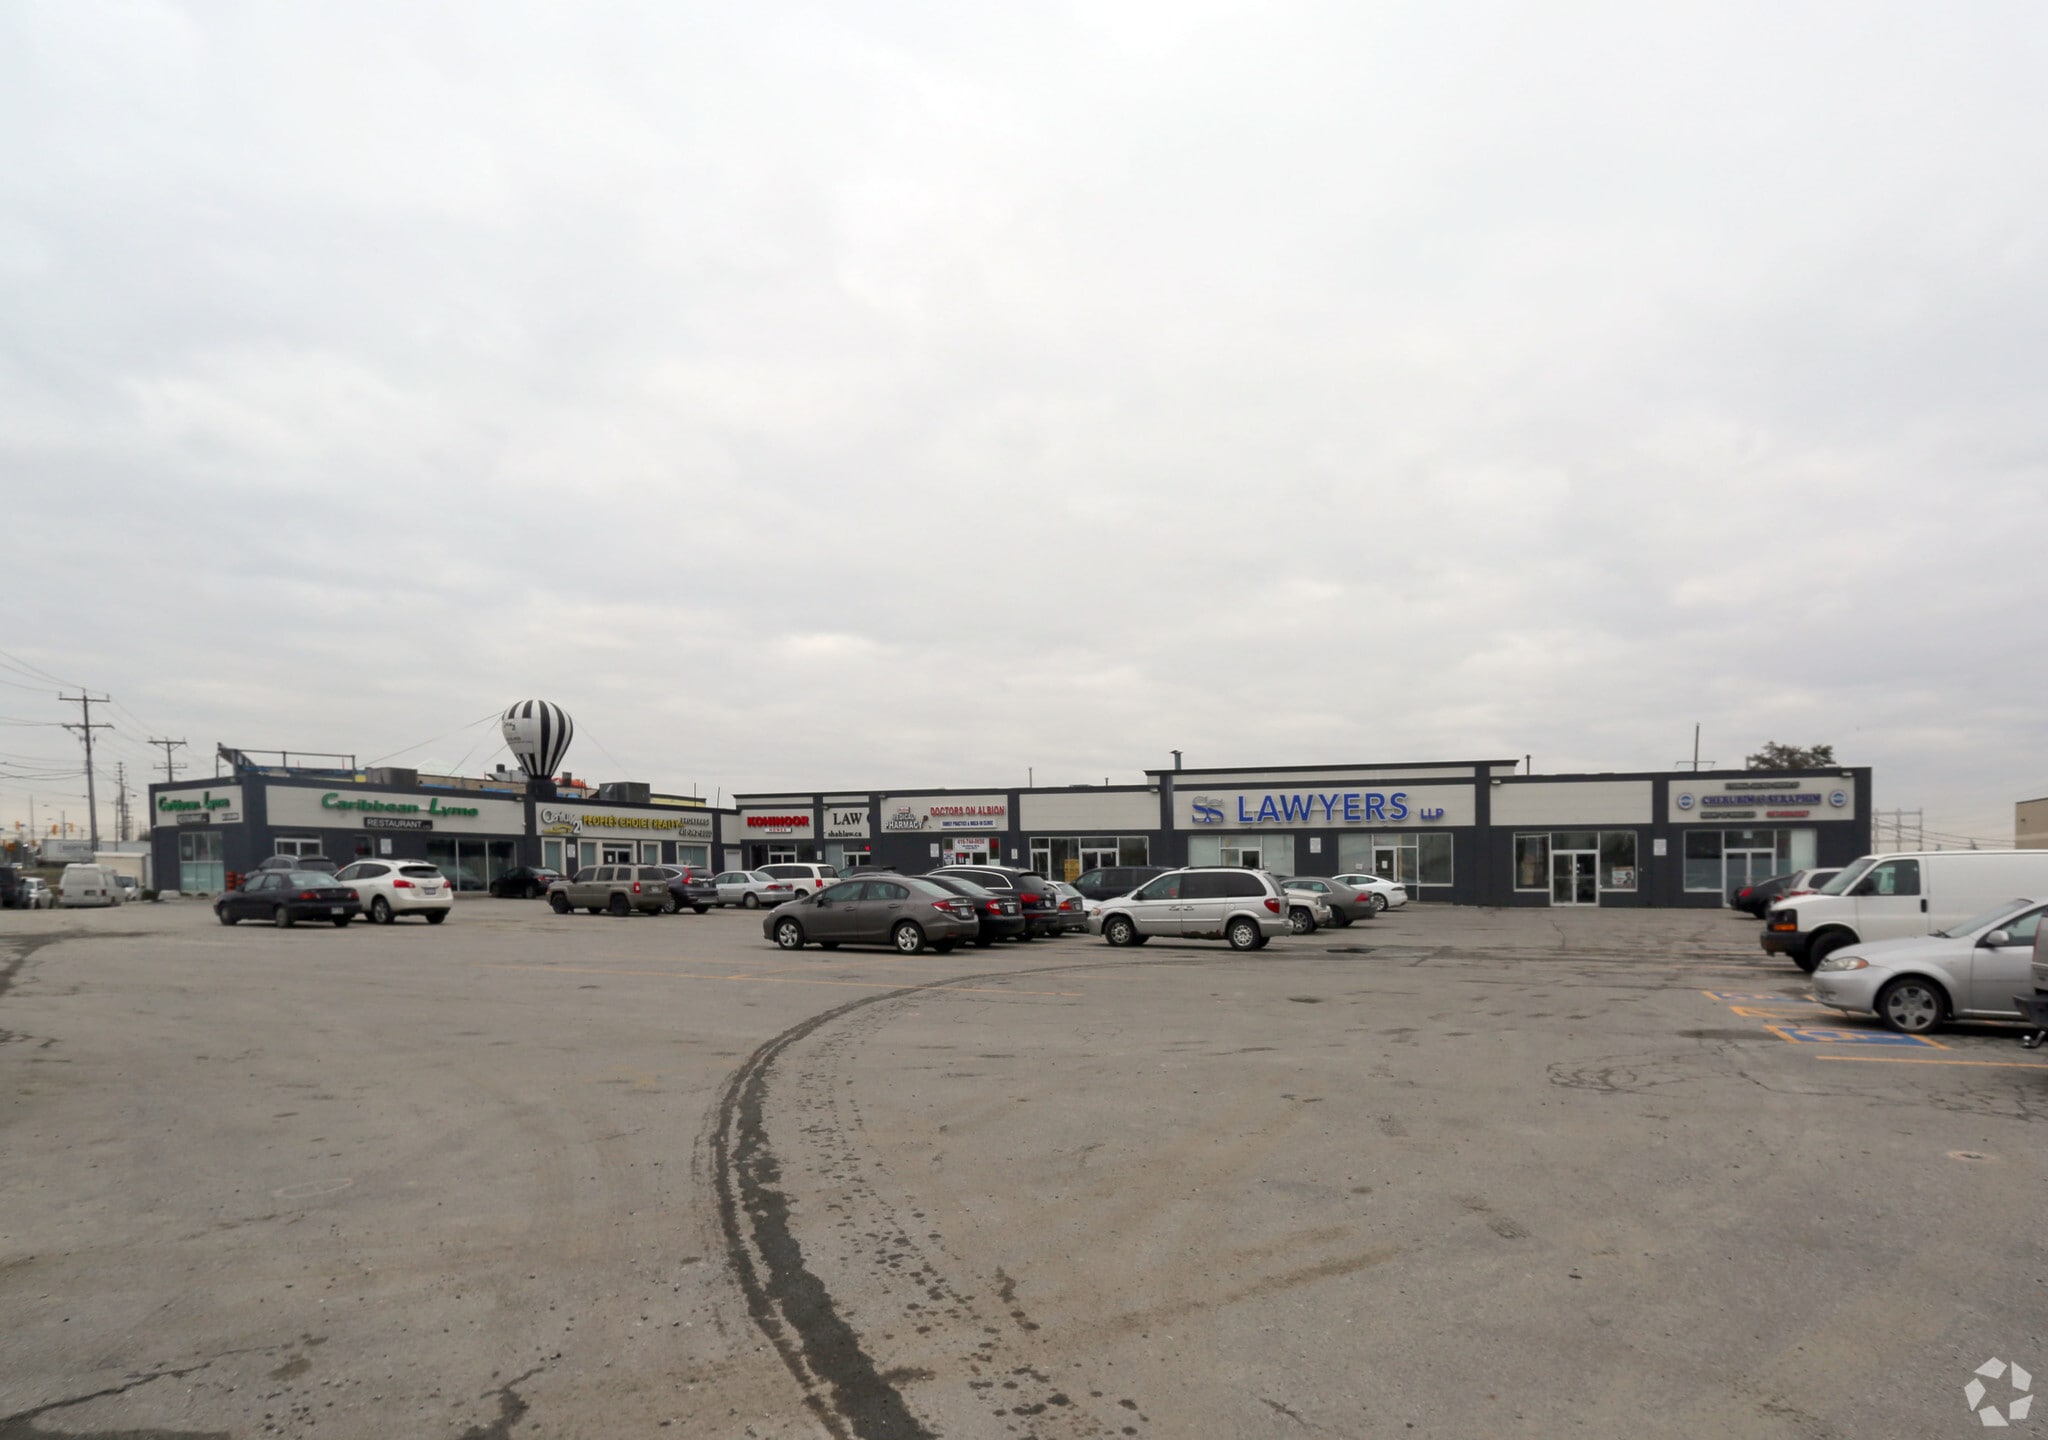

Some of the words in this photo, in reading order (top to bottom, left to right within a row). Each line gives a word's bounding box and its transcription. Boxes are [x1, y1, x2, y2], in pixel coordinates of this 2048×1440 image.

[321, 792, 419, 813] Caribbean
[429, 797, 479, 816] Lyme
[1238, 793, 1409, 822] LAWYERS
[1420, 808, 1445, 820] LLP
[930, 807, 963, 816] DOCTORS
[966, 807, 976, 815] ON
[978, 806, 1006, 815] ALBION
[366, 818, 422, 829] RESTAURANT
[542, 808, 576, 826] Century
[573, 820, 583, 834] 21
[747, 816, 809, 827] KOHINOOR
[833, 813, 862, 825] LAW
[885, 821, 923, 829] PHARMACY
